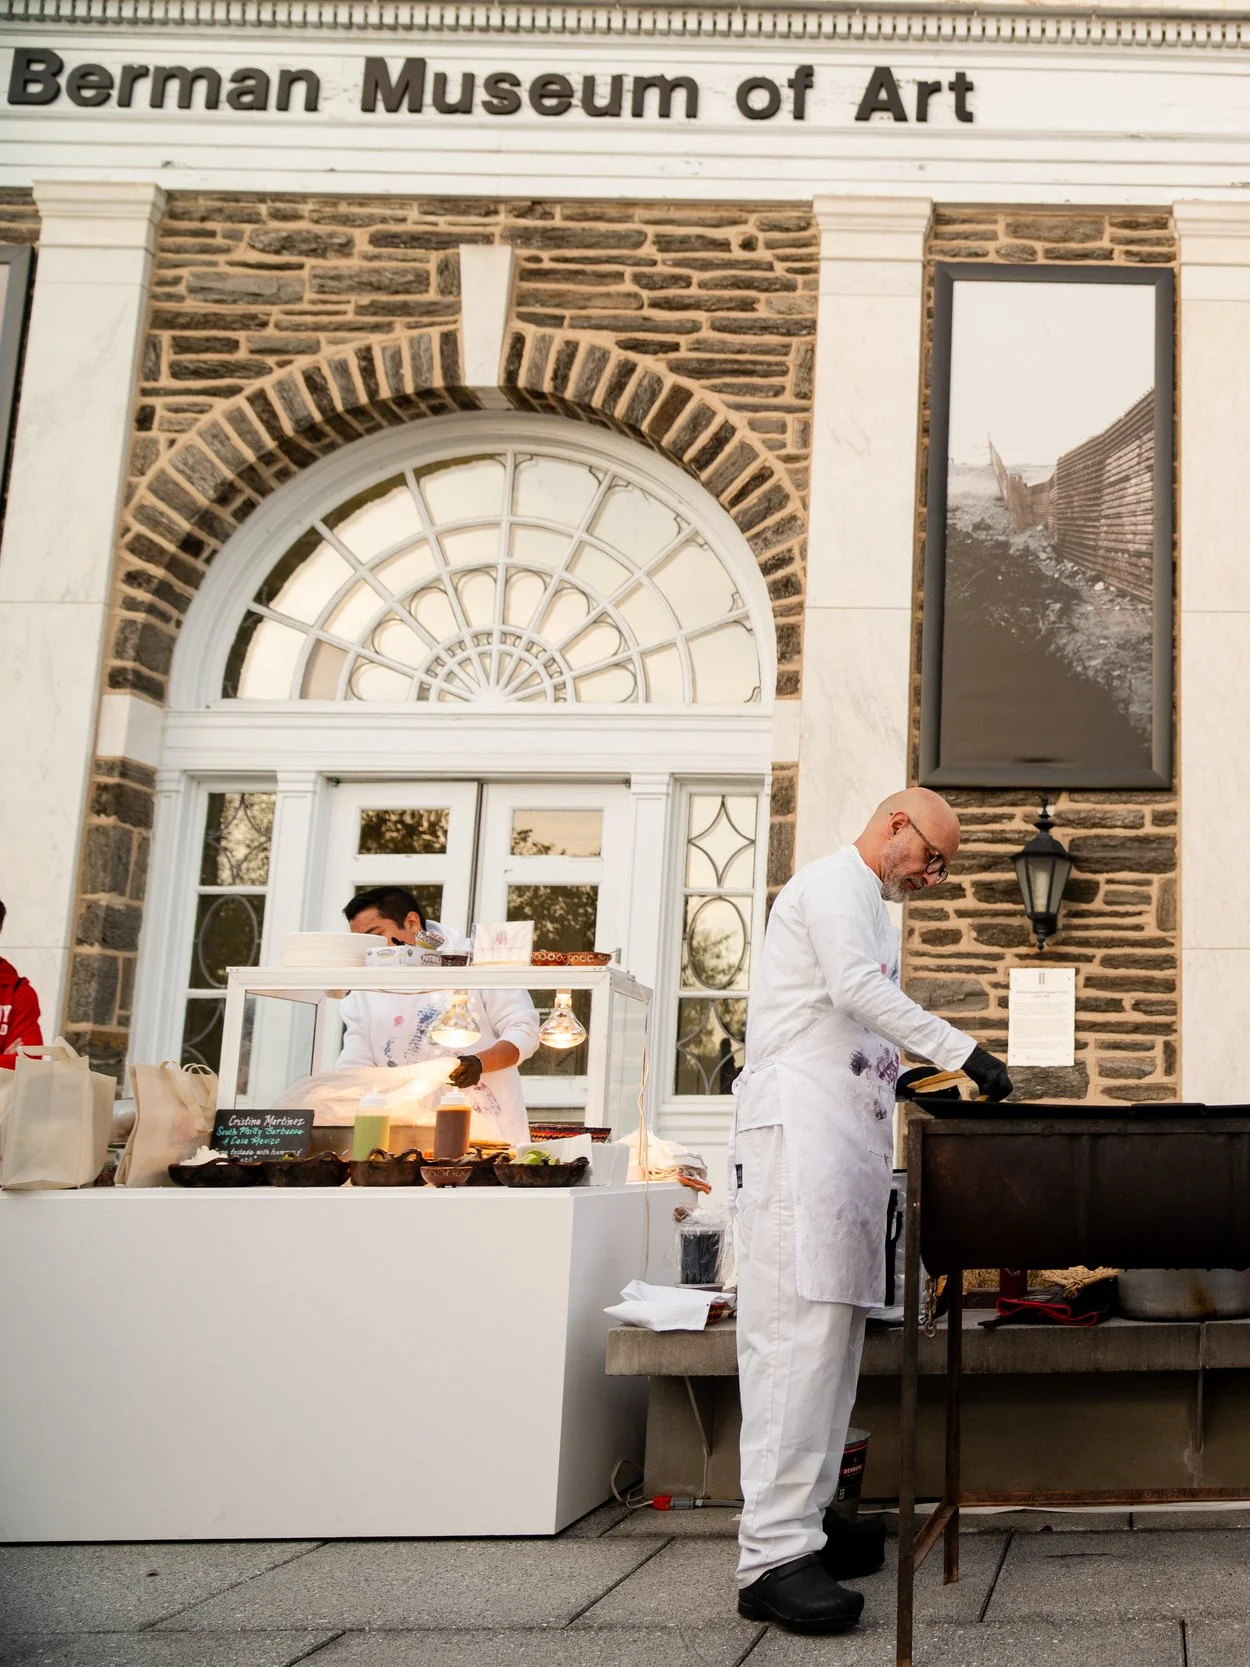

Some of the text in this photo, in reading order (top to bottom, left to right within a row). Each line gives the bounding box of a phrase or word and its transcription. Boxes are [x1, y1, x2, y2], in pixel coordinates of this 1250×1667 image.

[7, 47, 974, 123] Berman Museum of Art
[423, 954, 442, 963] NITRIL
[228, 1114, 305, 1126] Cristina Martinez
[217, 1126, 238, 1136] South
[239, 1126, 262, 1137] Philly
[251, 1137, 281, 1146] Mexico
